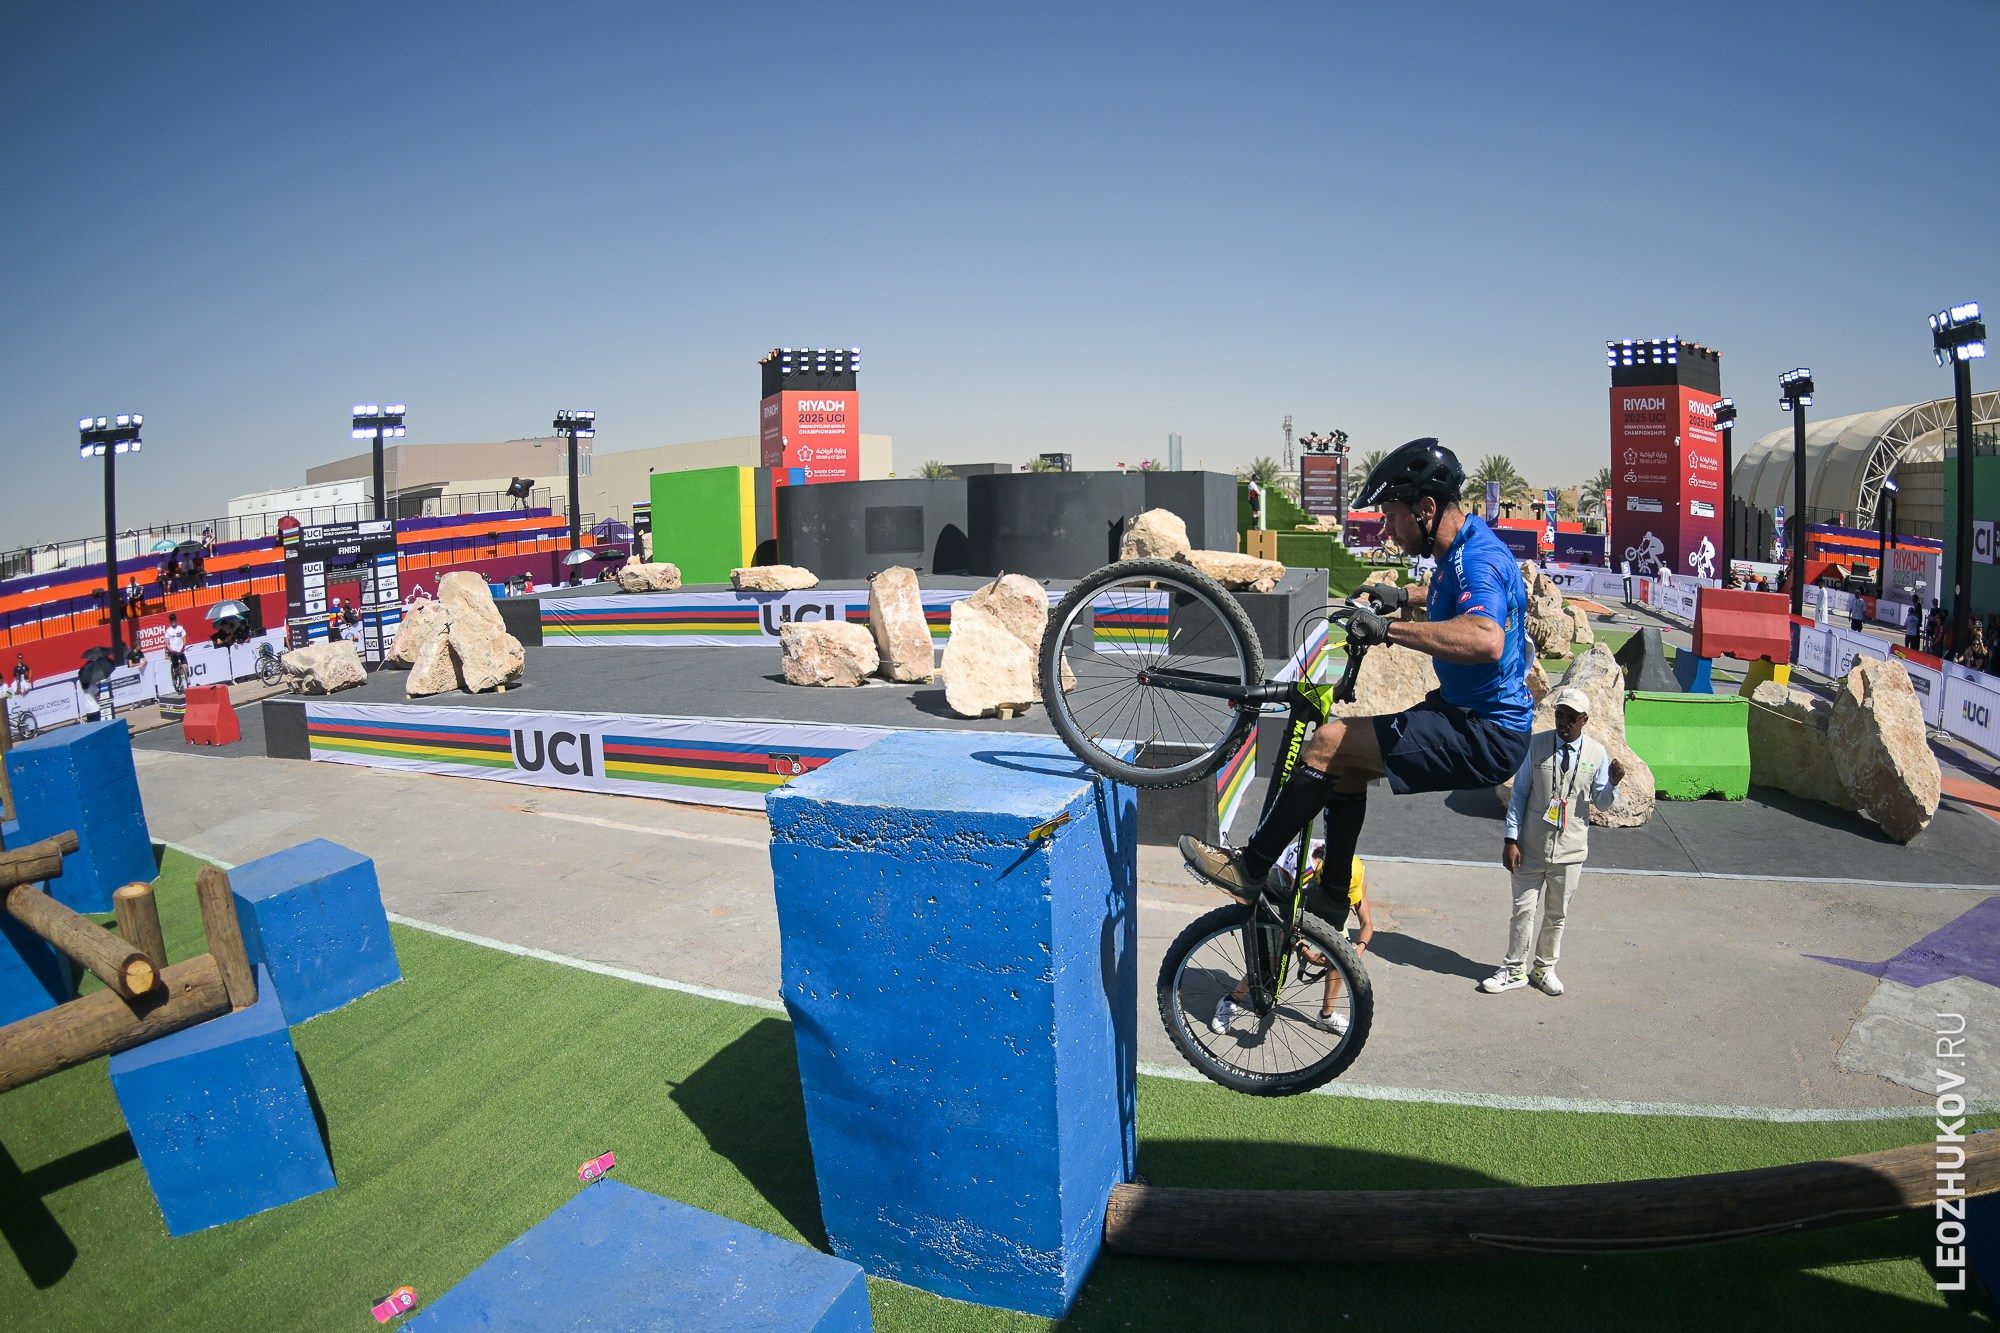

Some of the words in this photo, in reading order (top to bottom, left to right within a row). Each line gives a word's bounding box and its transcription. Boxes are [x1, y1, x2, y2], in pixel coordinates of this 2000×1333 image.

[798, 400, 844, 412] RIYADH
[1624, 398, 1664, 411] RIYADH
[798, 414, 824, 422] 2025
[826, 414, 845, 422] UCI
[1624, 412, 1647, 422] 2025
[1649, 412, 1666, 422] UCI
[1689, 415, 1704, 427] 2025
[308, 529, 322, 538] UCI
[1976, 528, 1990, 555] CI
[339, 546, 360, 555] FINISH
[1894, 551, 1926, 573] RIYADH
[136, 625, 166, 639] RIYADH
[141, 639, 153, 647] 025
[47, 698, 71, 708] CYCLING
[1968, 703, 1988, 728] UCI
[514, 729, 593, 776] UCI
